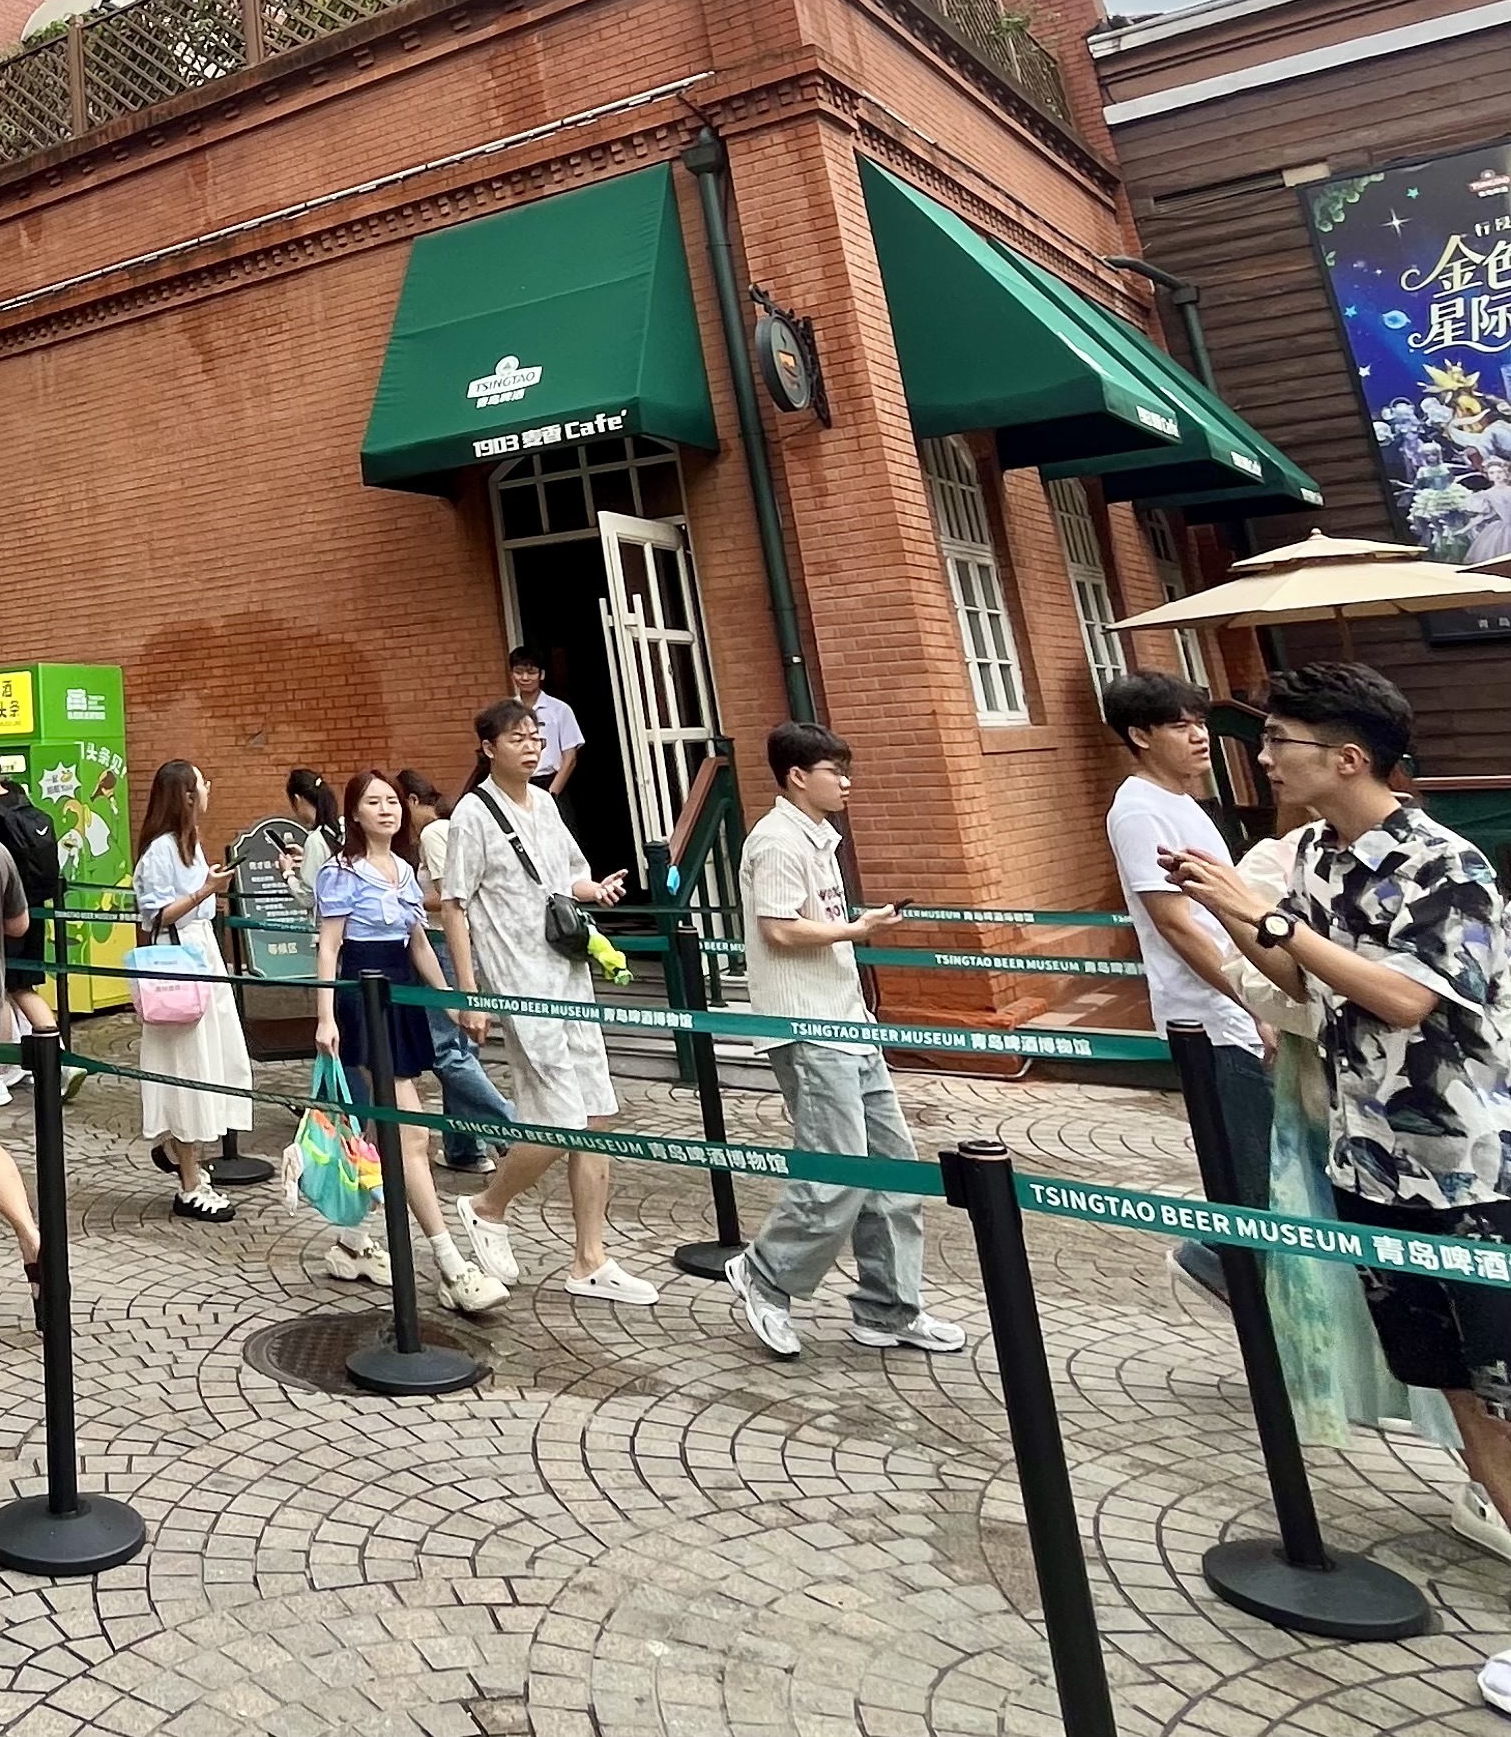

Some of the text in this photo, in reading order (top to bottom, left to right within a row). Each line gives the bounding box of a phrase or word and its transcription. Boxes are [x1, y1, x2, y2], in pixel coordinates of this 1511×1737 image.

[476, 371, 536, 392] TSINGTAO
[472, 434, 520, 457] 1903
[935, 953, 992, 968] TSINGTAO
[993, 956, 1025, 970] BEER
[1026, 959, 1080, 972] MUSEUM
[466, 995, 519, 1012] TSINGTAO
[520, 1001, 550, 1015] BEER
[550, 1005, 600, 1020] MUSEUM
[791, 1021, 1093, 1056] TSINGTAO BEER MUSEUM 青岛啤酒博物馆
[446, 1118, 790, 1175] TSINGTAO BEER MUSEUM 青岛啤酒博物馆
[1029, 1183, 1511, 1282] TSINGTAO BEER MUSEUM 青岛啤酒
